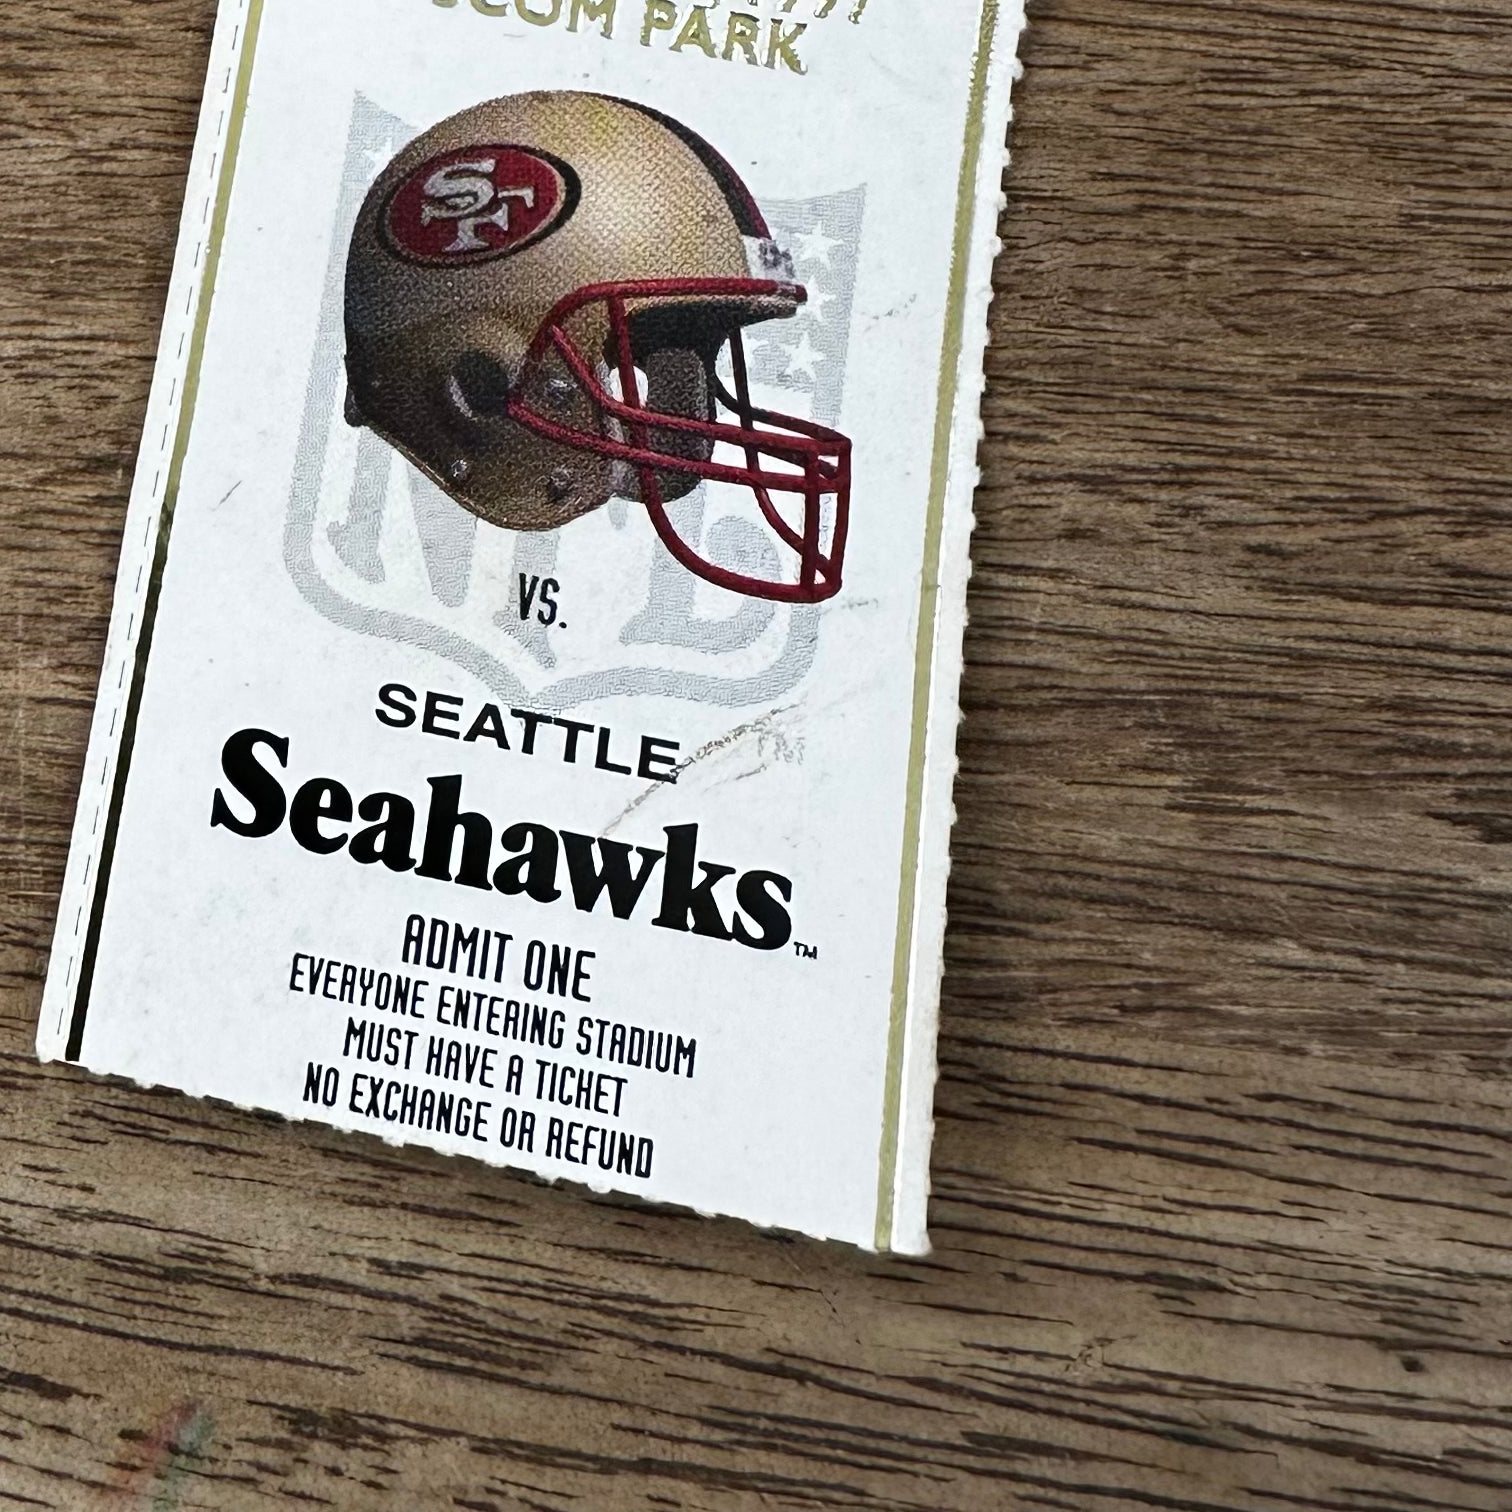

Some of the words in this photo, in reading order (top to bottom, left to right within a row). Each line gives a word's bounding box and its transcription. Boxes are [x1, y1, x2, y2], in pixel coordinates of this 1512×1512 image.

[519, 573, 567, 628] VS.
[376, 684, 681, 784] SEATTLE
[210, 728, 792, 950] Seahawks
[402, 914, 513, 983] ADMIT
[524, 940, 595, 1002] ONE
[290, 953, 429, 1018] EVERYONE
[437, 986, 565, 1048] ENTERING
[576, 1017, 696, 1078] STADIUM
[343, 1017, 419, 1069] MUST
[426, 1036, 497, 1088] HAVE
[506, 1055, 523, 1095] A
[536, 1059, 628, 1117] TICKET
[303, 1062, 339, 1106] NO
[349, 1073, 491, 1142] EXCHANGE
[500, 1107, 535, 1153] OR
[546, 1117, 653, 1178] REFUND
